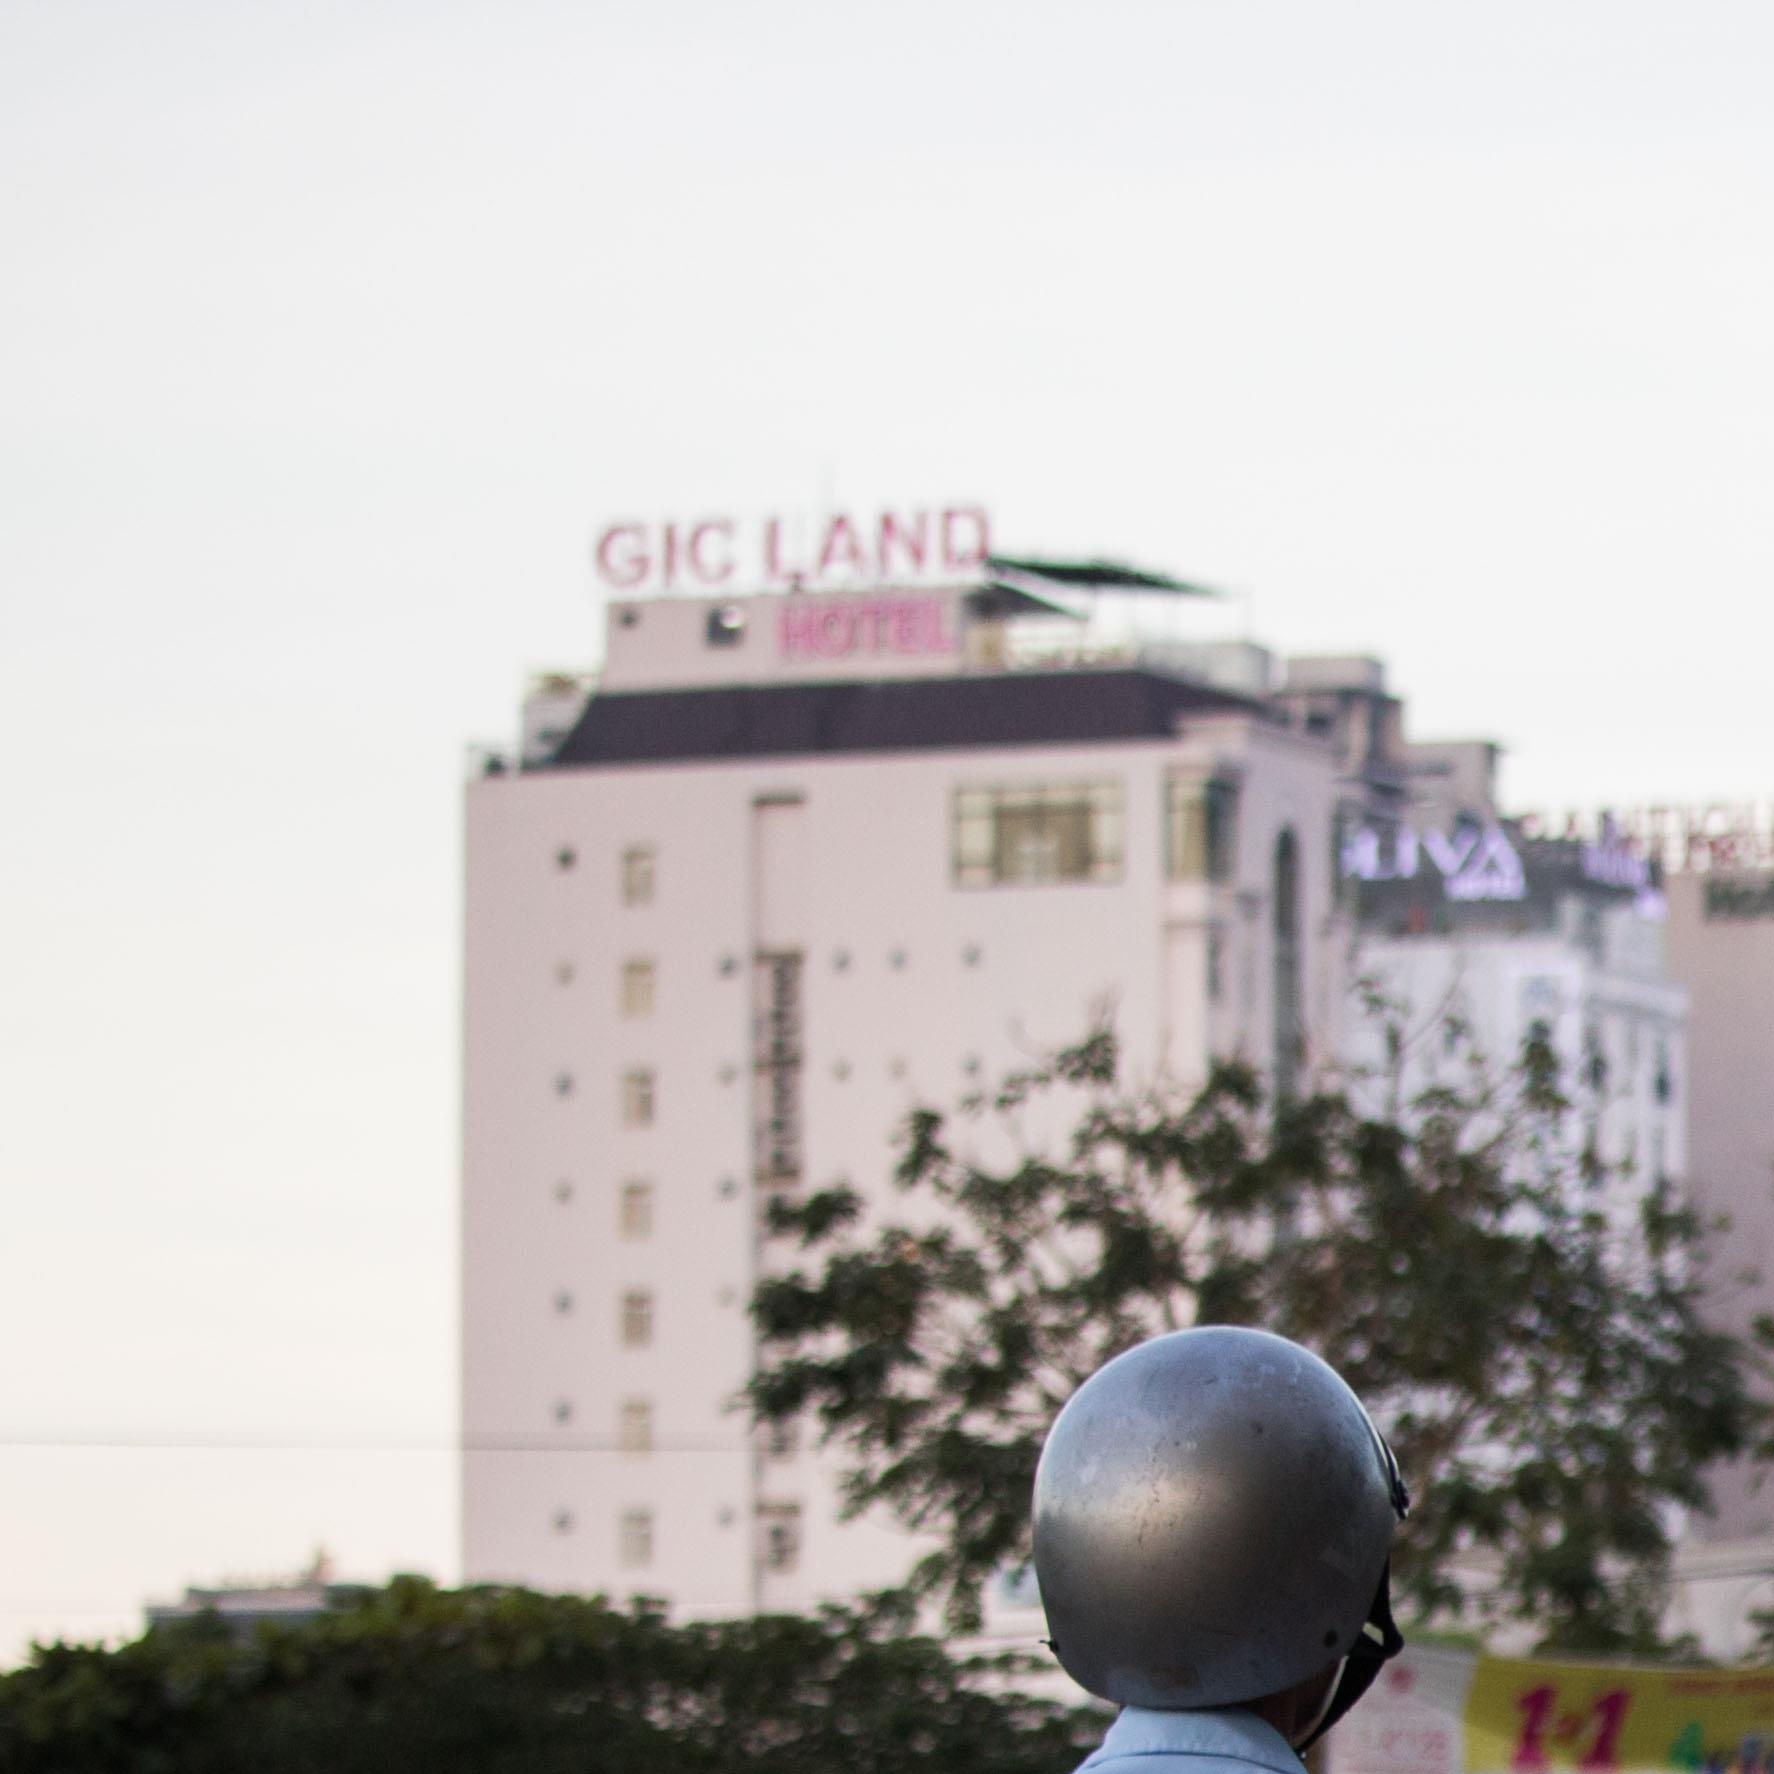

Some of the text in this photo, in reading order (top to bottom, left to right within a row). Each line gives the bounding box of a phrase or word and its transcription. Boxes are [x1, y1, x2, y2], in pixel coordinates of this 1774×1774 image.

[595, 506, 991, 588] GIC LAND
[776, 600, 954, 659] HOTEL
